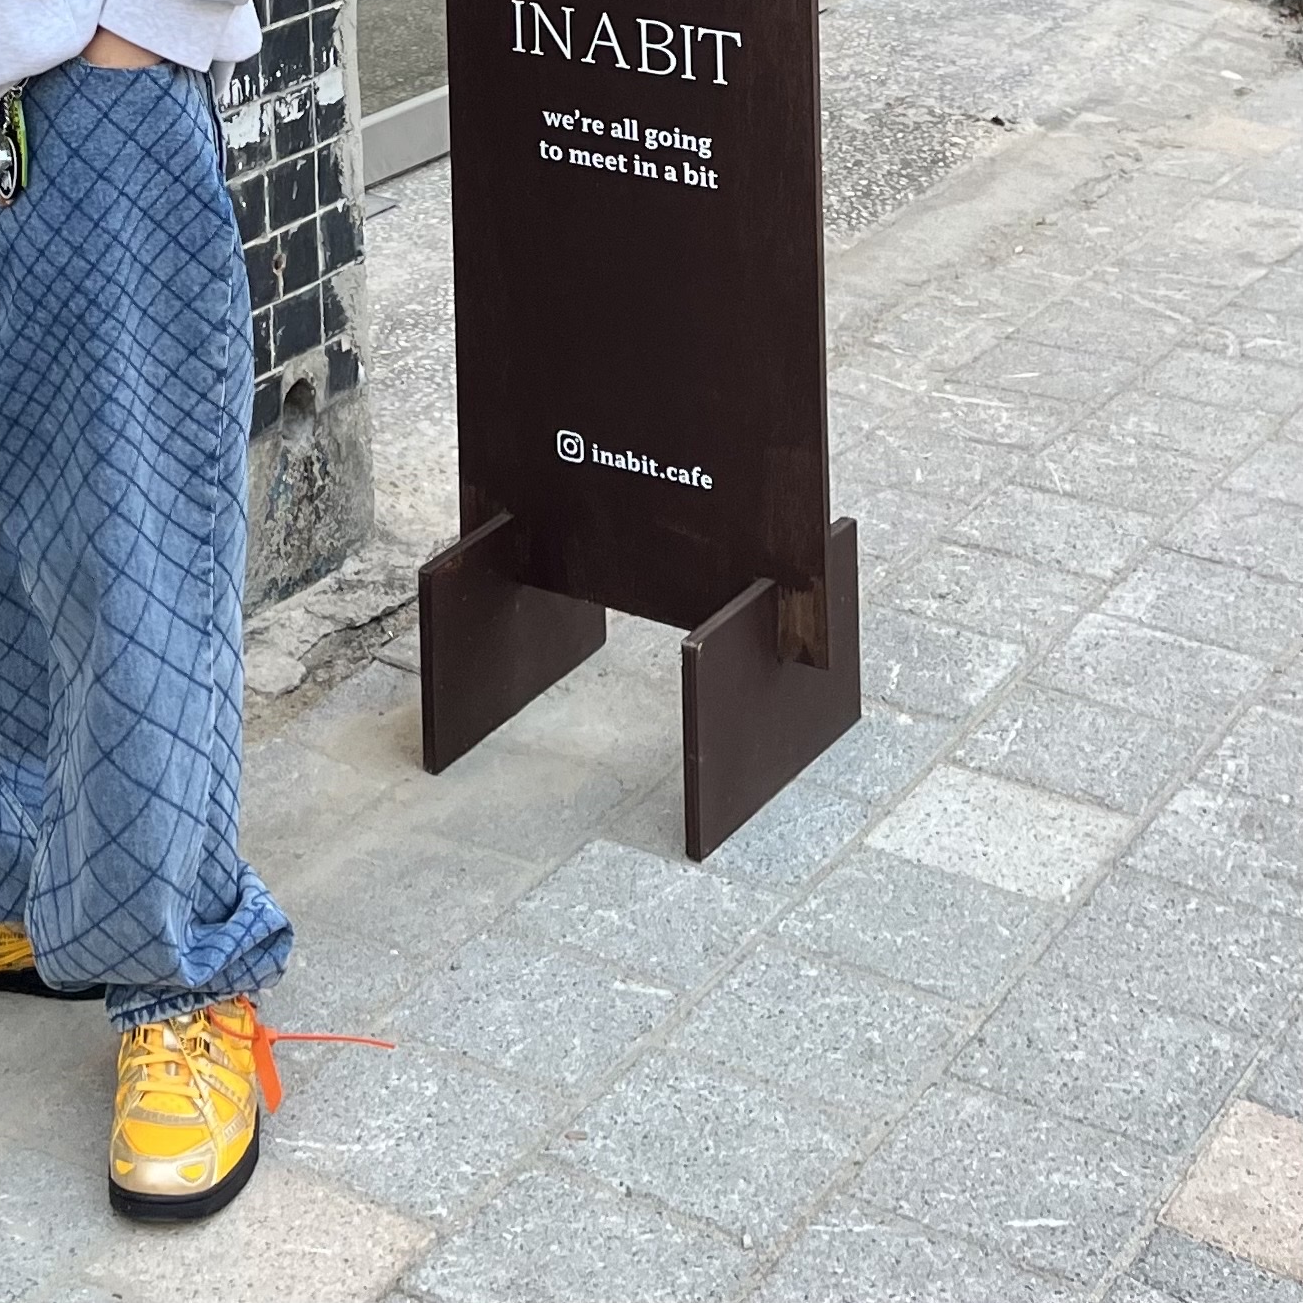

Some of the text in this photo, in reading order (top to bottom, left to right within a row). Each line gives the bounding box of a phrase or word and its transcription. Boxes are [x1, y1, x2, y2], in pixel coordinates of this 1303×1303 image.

[542, 109, 713, 159] we're all going
[539, 140, 718, 189] to meet in a bit
[591, 443, 714, 490] inabit.cafe
